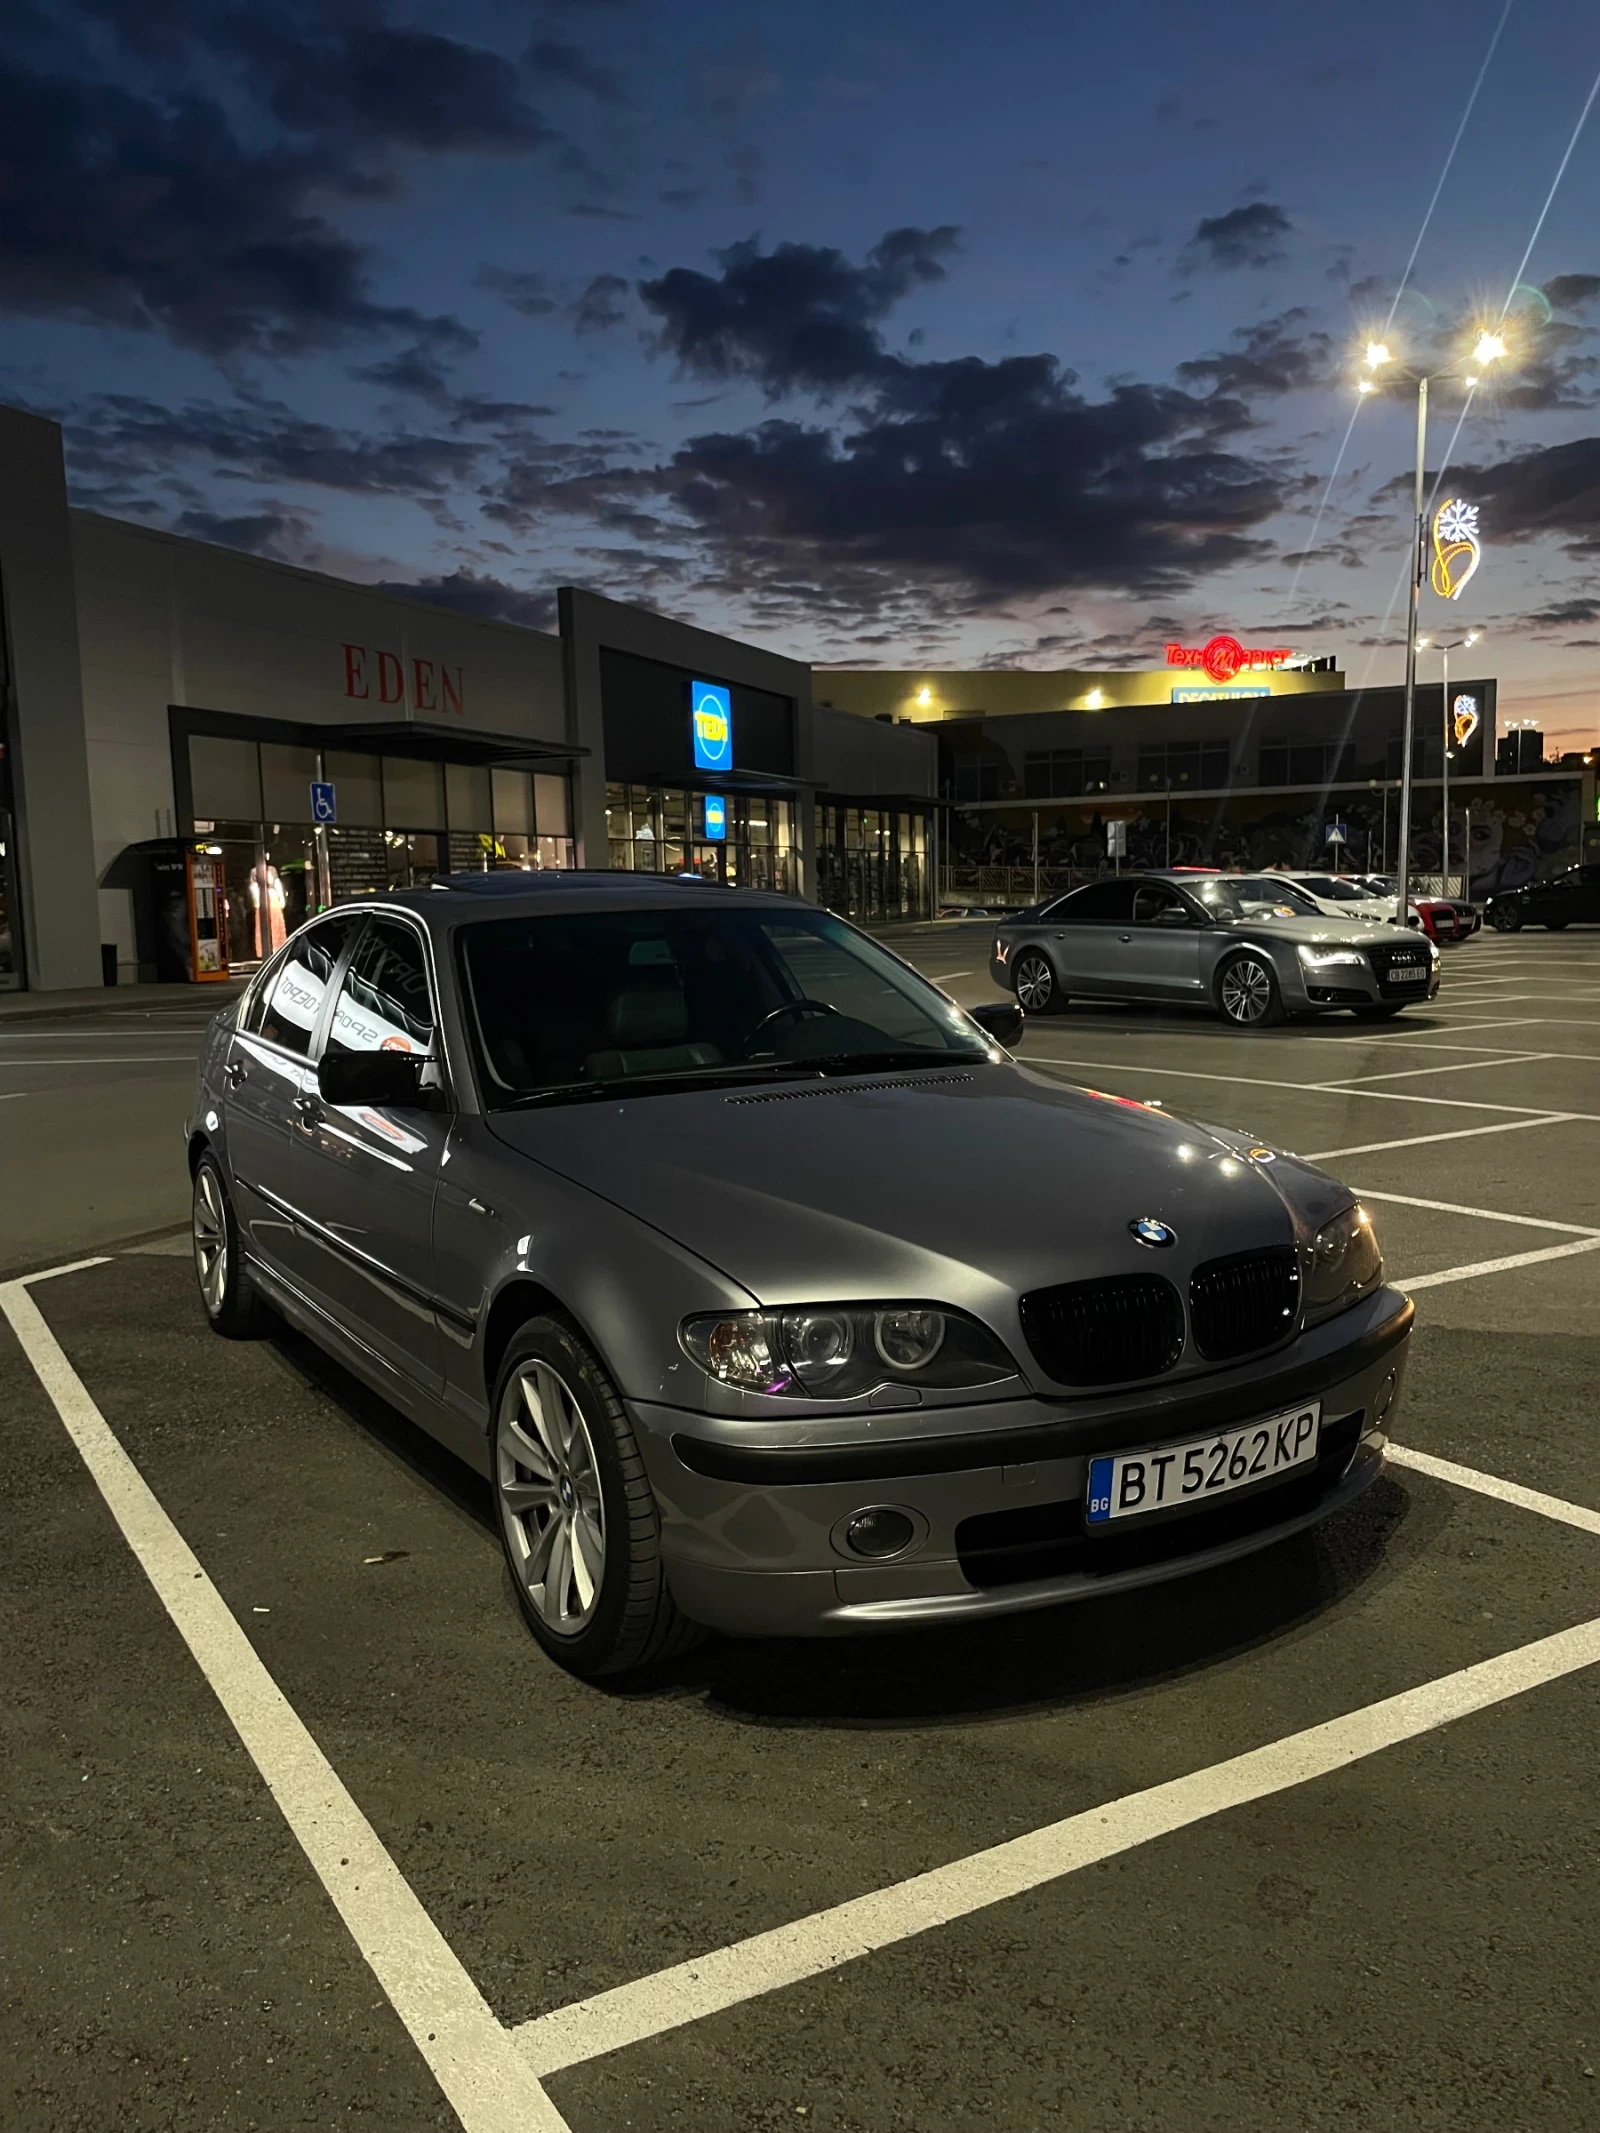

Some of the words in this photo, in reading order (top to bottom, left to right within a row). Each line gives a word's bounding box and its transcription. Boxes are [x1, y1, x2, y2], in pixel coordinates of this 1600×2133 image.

[341, 643, 465, 716] EDEN
[694, 710, 728, 742] TEDi
[1090, 1498, 1109, 1513] BG
